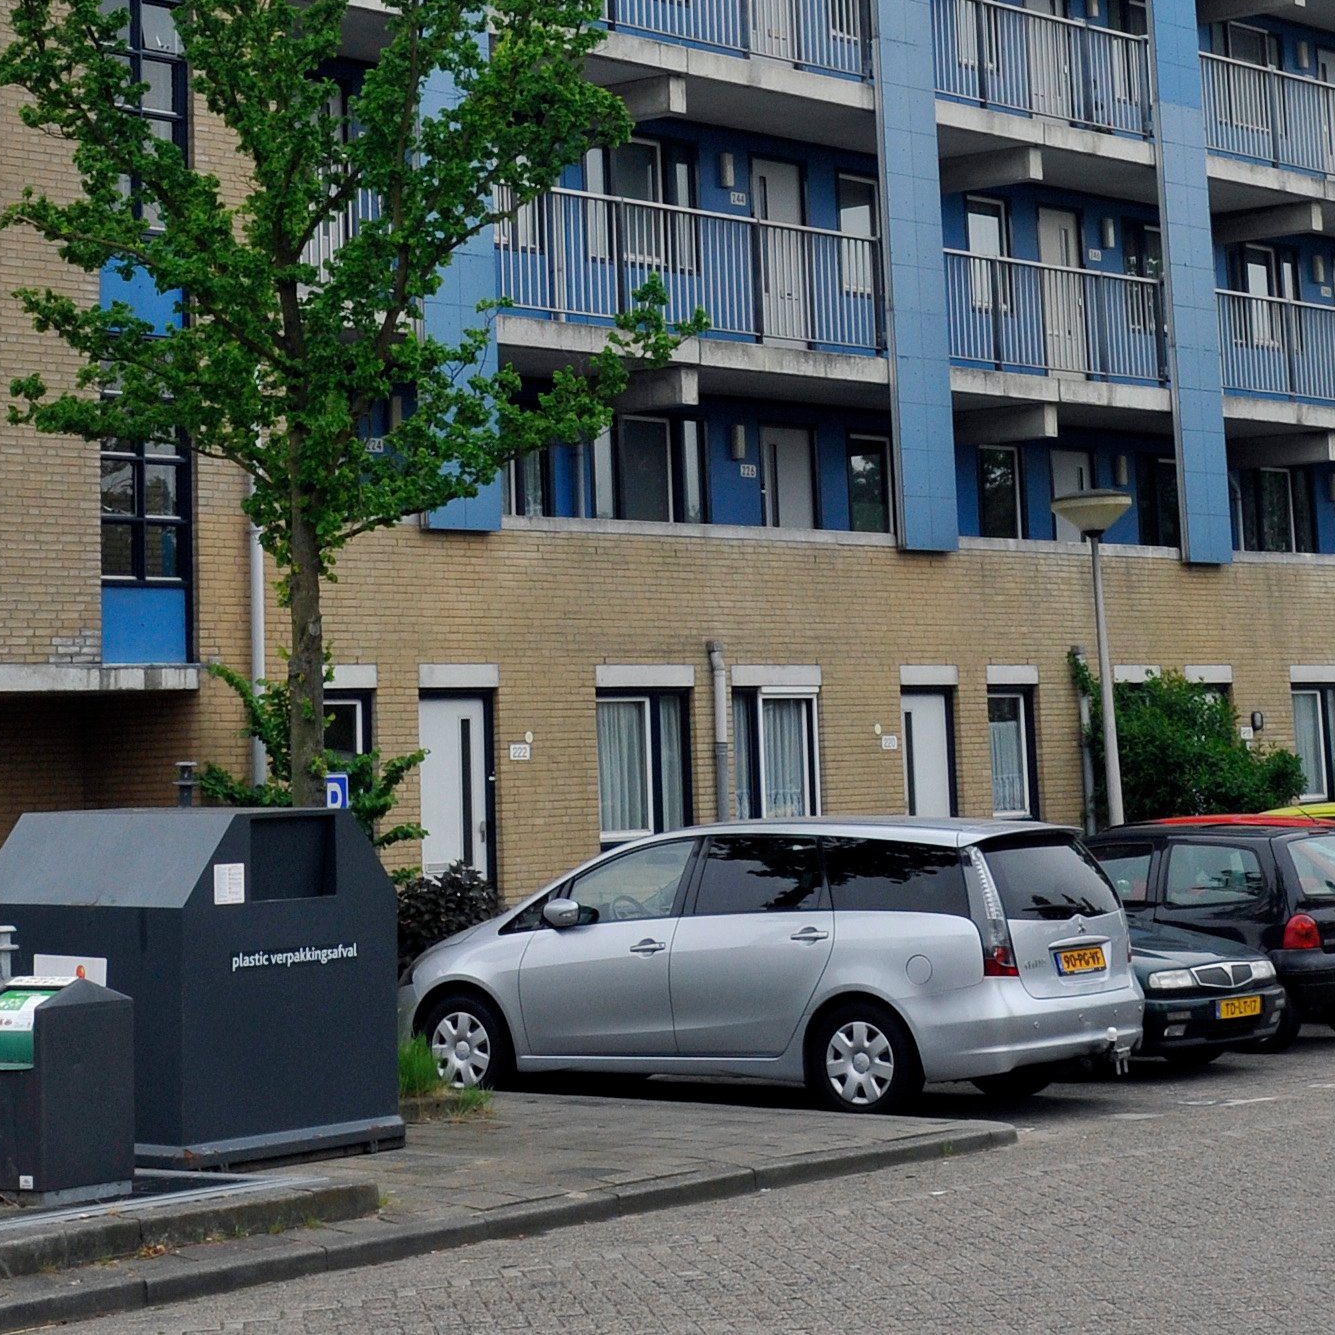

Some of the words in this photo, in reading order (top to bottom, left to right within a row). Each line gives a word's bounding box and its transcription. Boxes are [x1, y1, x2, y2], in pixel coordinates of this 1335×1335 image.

[512, 746, 528, 758] 222
[232, 951, 269, 972] plastic
[270, 942, 358, 967] verpakkingsafval
